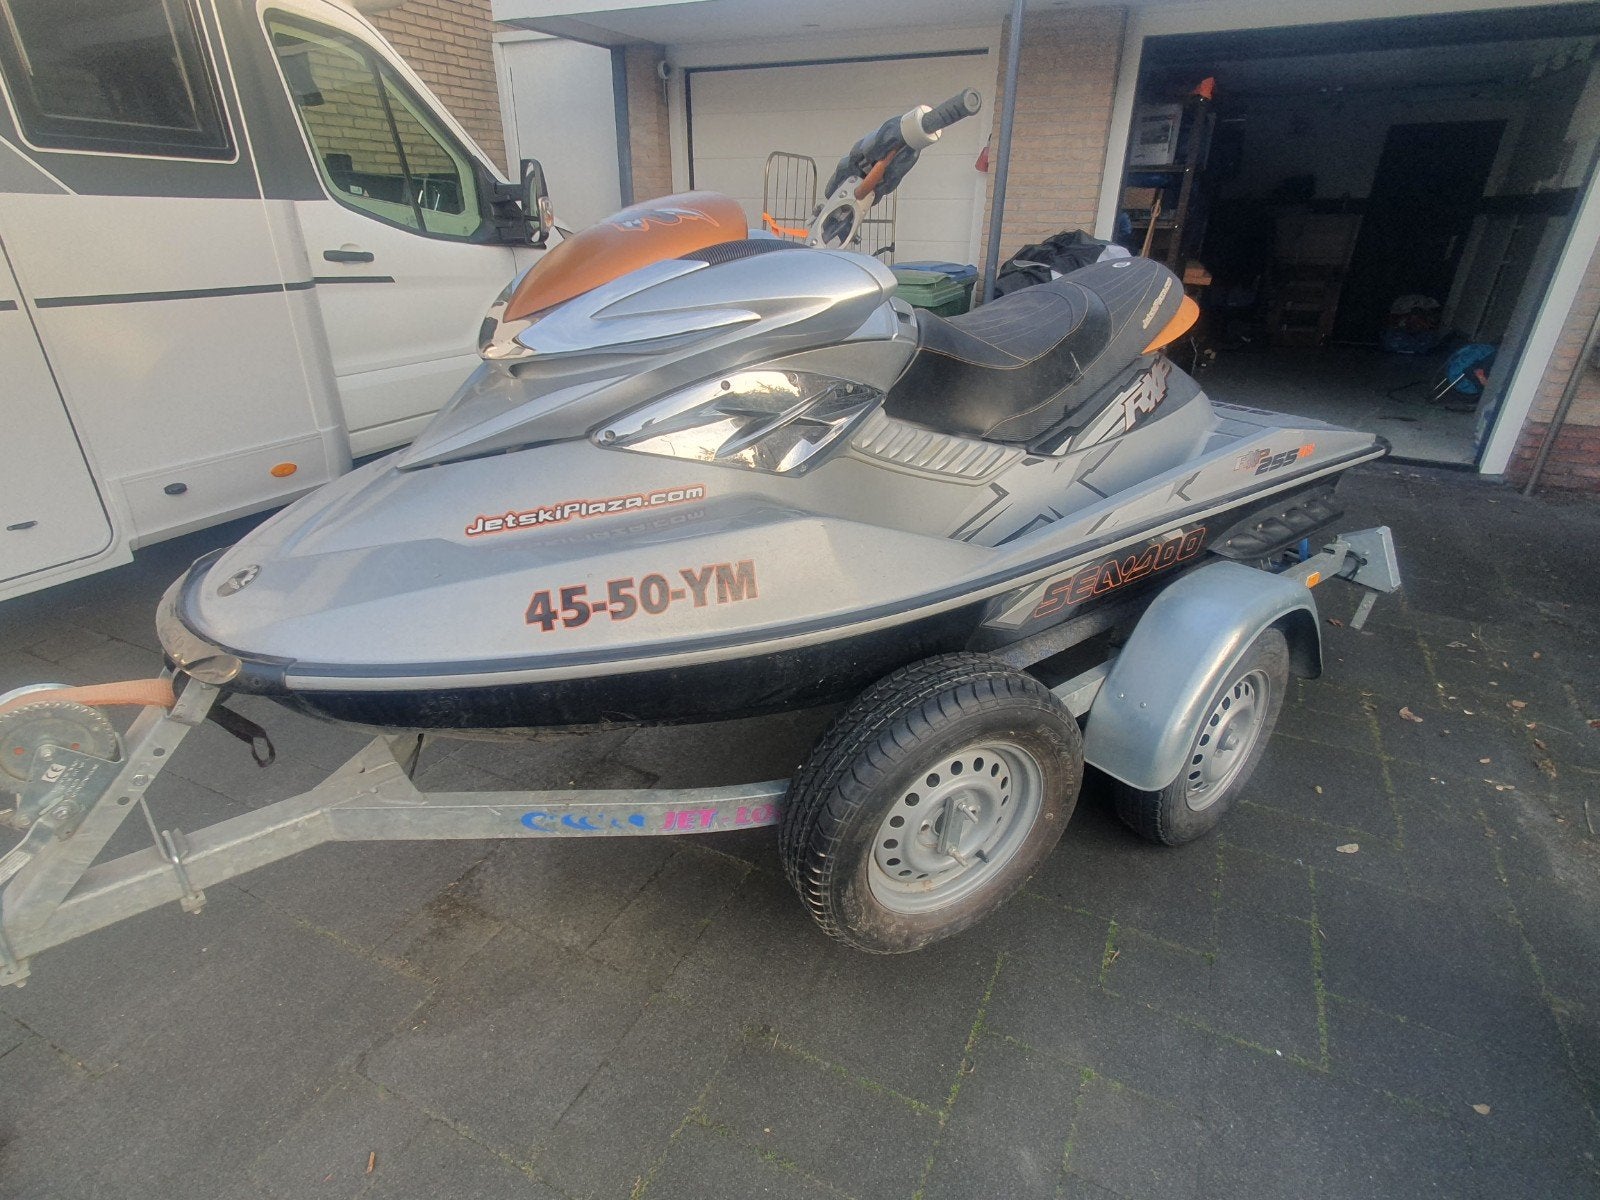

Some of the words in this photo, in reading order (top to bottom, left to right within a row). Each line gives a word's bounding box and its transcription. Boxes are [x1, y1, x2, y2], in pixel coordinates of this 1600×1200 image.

[1254, 448, 1300, 476] 255
[465, 484, 706, 536] JetskiPlaza.com
[525, 559, 758, 632] 45-50-YM
